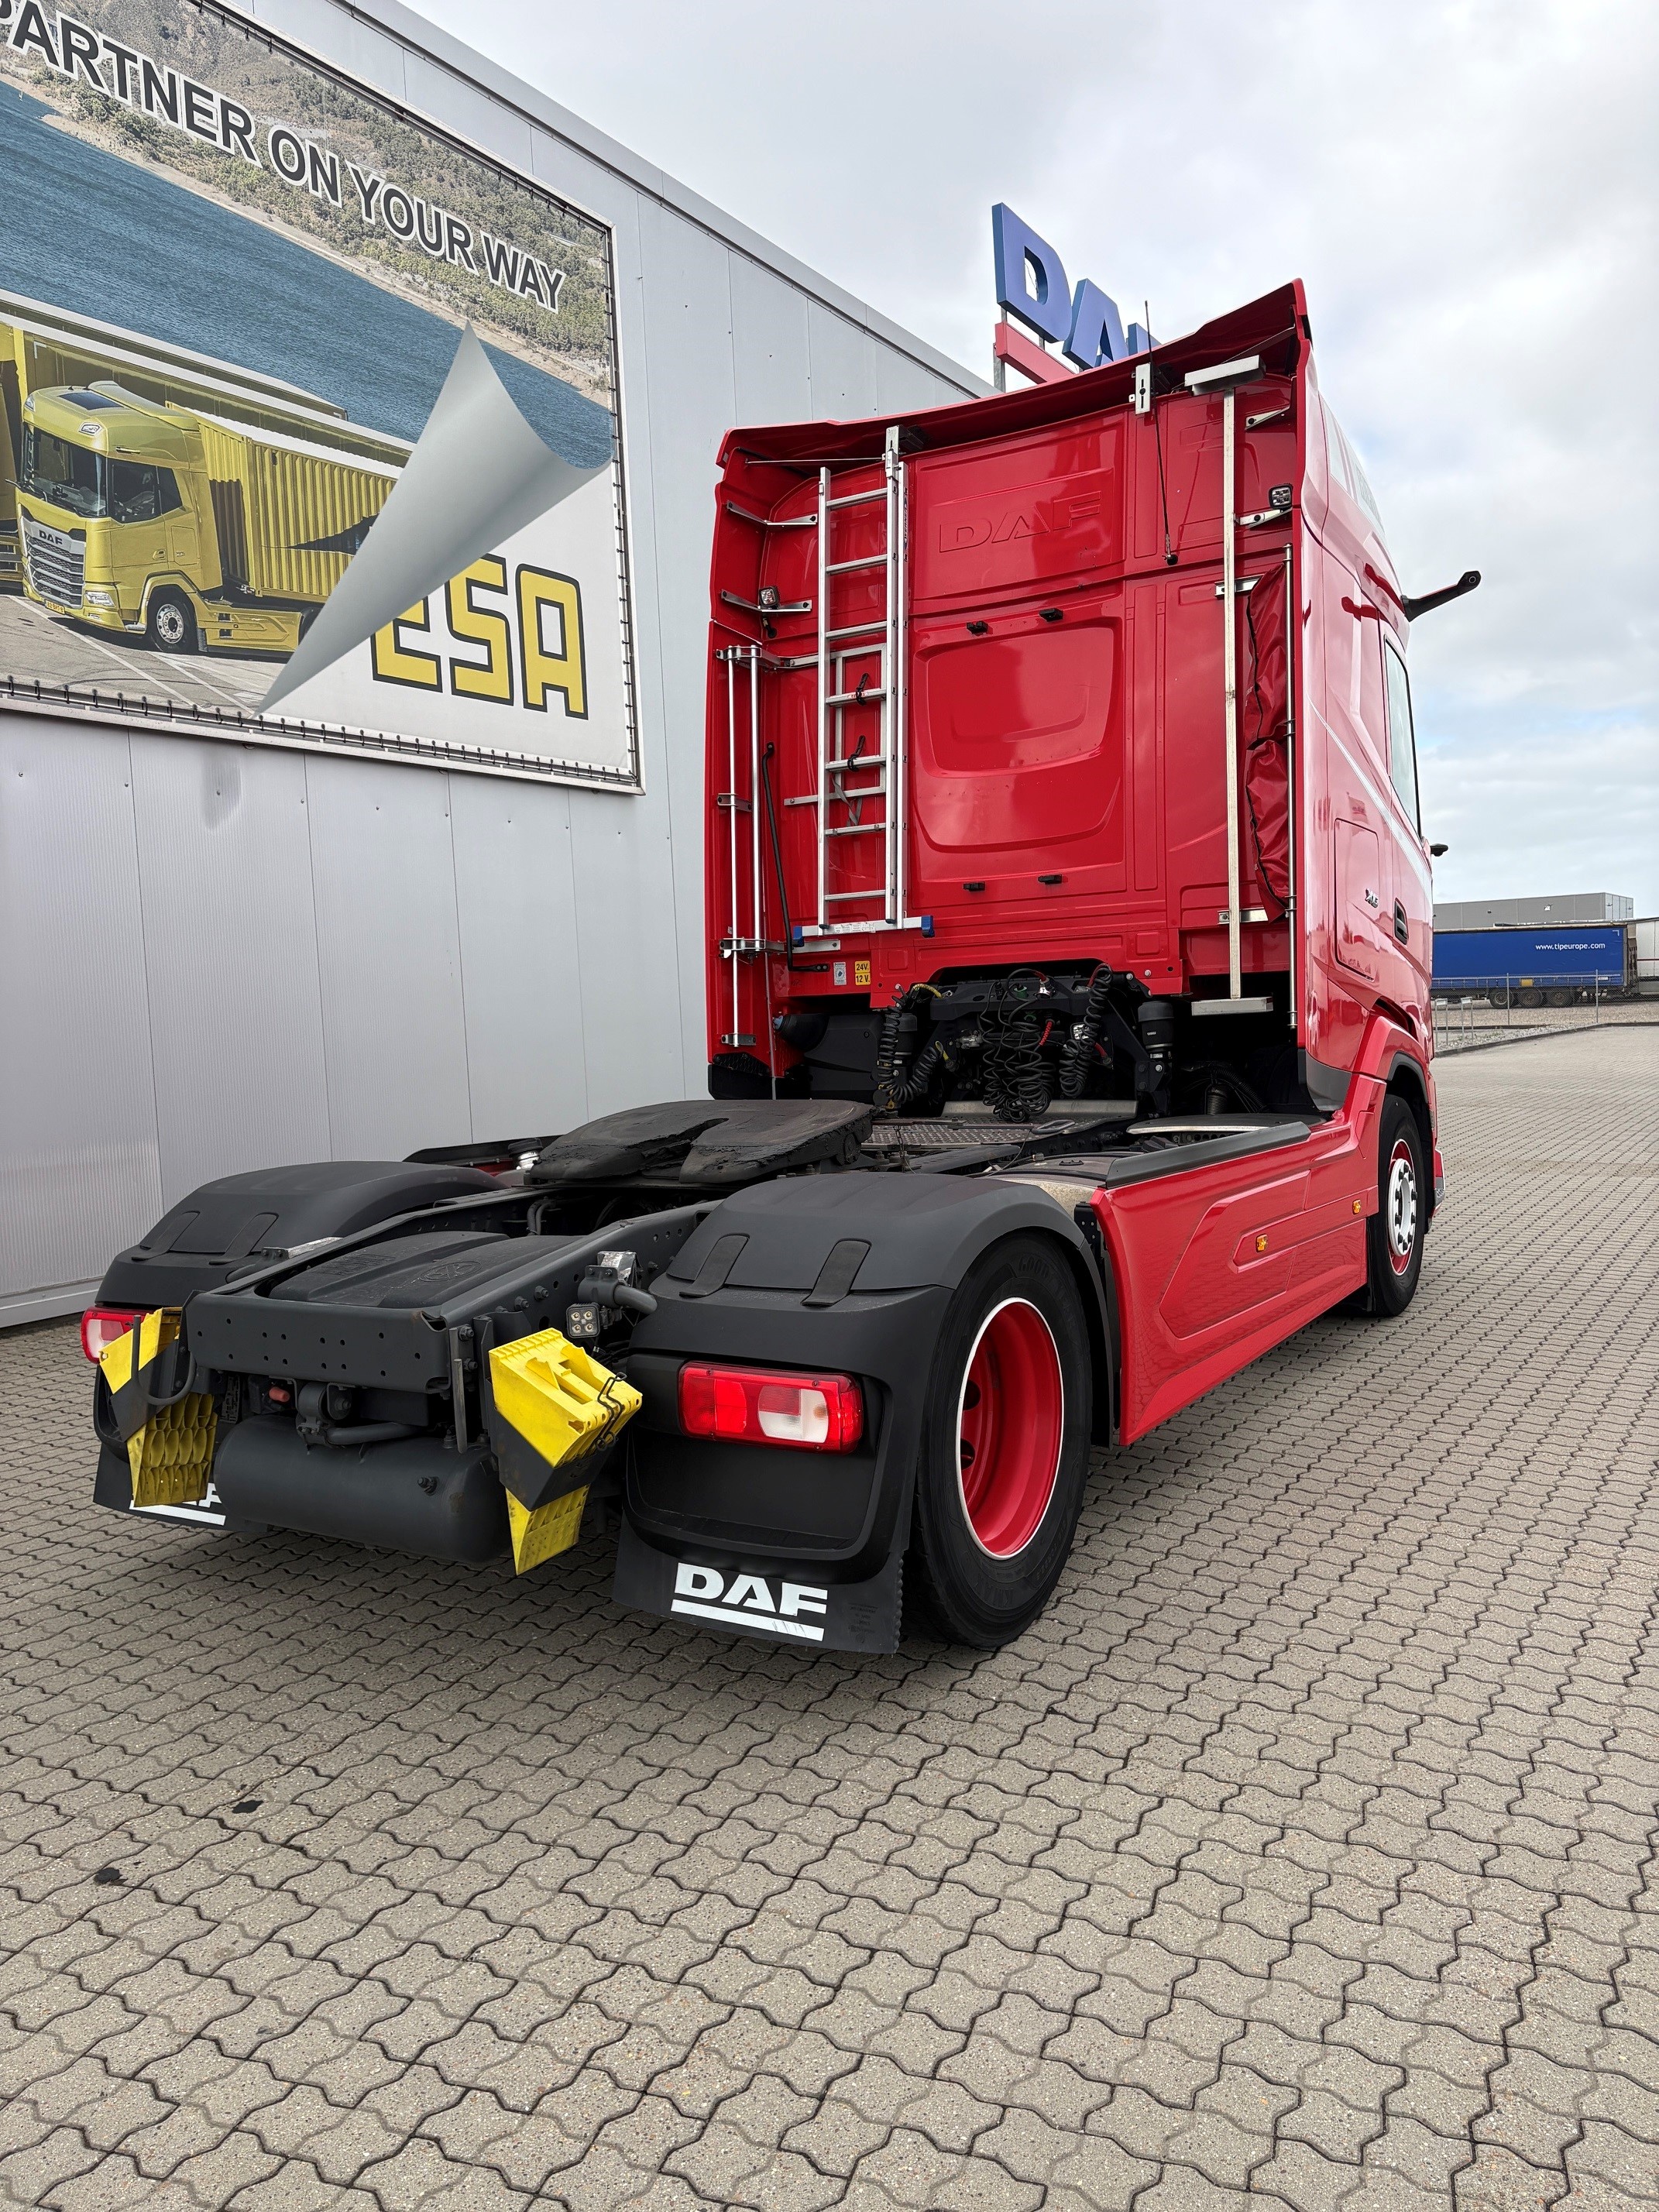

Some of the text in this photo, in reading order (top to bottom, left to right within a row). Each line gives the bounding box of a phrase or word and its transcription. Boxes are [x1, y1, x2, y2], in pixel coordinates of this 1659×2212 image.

[270, 126, 340, 205] ON
[349, 163, 476, 273] YOUR
[482, 234, 565, 311] WAY
[991, 202, 1162, 368] DA
[39, 530, 63, 544] DAF
[939, 490, 1101, 552] DAF
[1535, 943, 1606, 951] www.tipeurope.com
[675, 1562, 828, 1616] DAF
